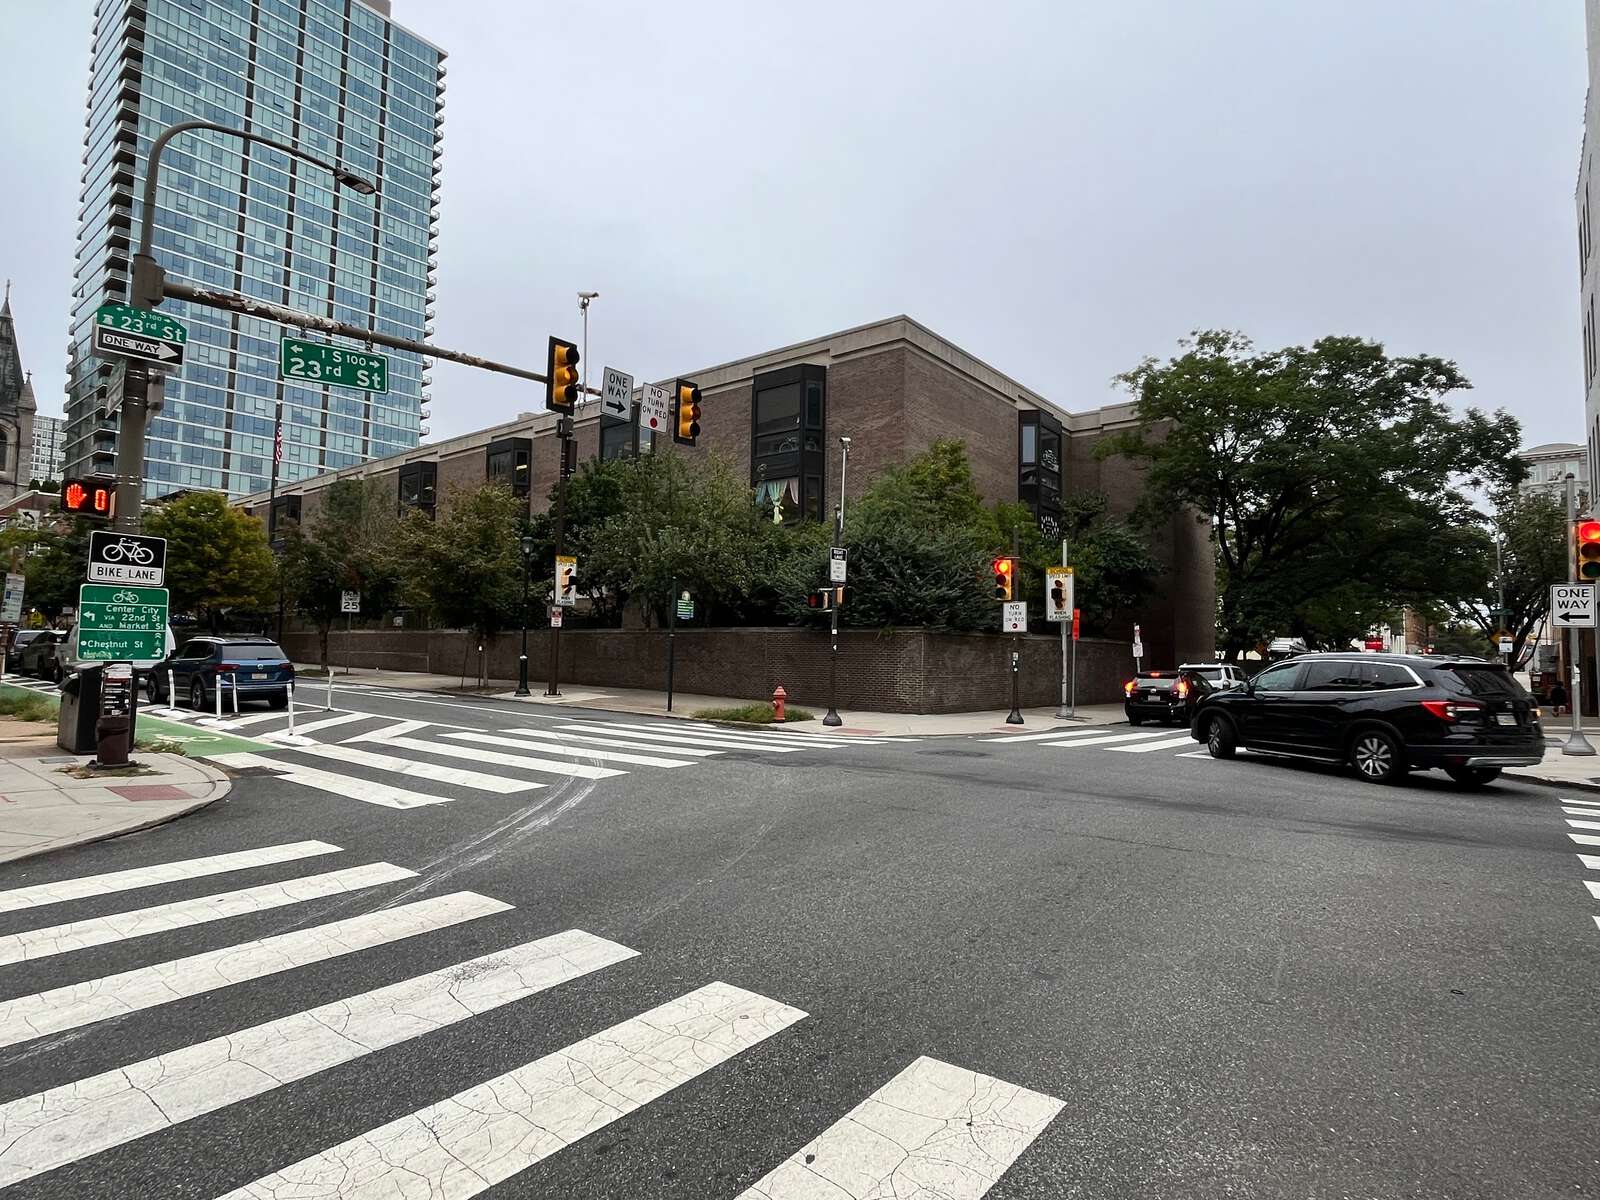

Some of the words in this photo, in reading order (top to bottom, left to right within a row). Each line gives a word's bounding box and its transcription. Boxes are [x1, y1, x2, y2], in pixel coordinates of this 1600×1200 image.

[140, 311, 147, 319] S
[149, 314, 162, 322] 100
[120, 316, 157, 333] 23rd
[162, 326, 183, 343] St
[104, 335, 130, 348] ONE
[134, 342, 160, 354] WAY
[332, 351, 342, 363] S
[346, 354, 367, 367] 100
[289, 357, 342, 378] 23rd
[356, 369, 381, 389] St
[609, 373, 628, 388] ONE
[607, 385, 628, 400] WAY
[650, 387, 663, 399] NO
[648, 397, 665, 409] TURN
[642, 405, 651, 414] ON
[655, 409, 667, 420] RED
[97, 566, 123, 578] BIKE
[128, 569, 156, 580] LANE
[1557, 588, 1590, 598] ONE
[105, 604, 136, 613] Center
[141, 606, 159, 615] City
[344, 601, 358, 610] 25
[1557, 599, 1590, 609] WAY
[121, 613, 146, 622] 22nd
[151, 614, 161, 622] St
[119, 622, 149, 630] Market
[155, 622, 165, 630] St
[87, 639, 128, 649] Chestnut
[134, 640, 144, 649] St
